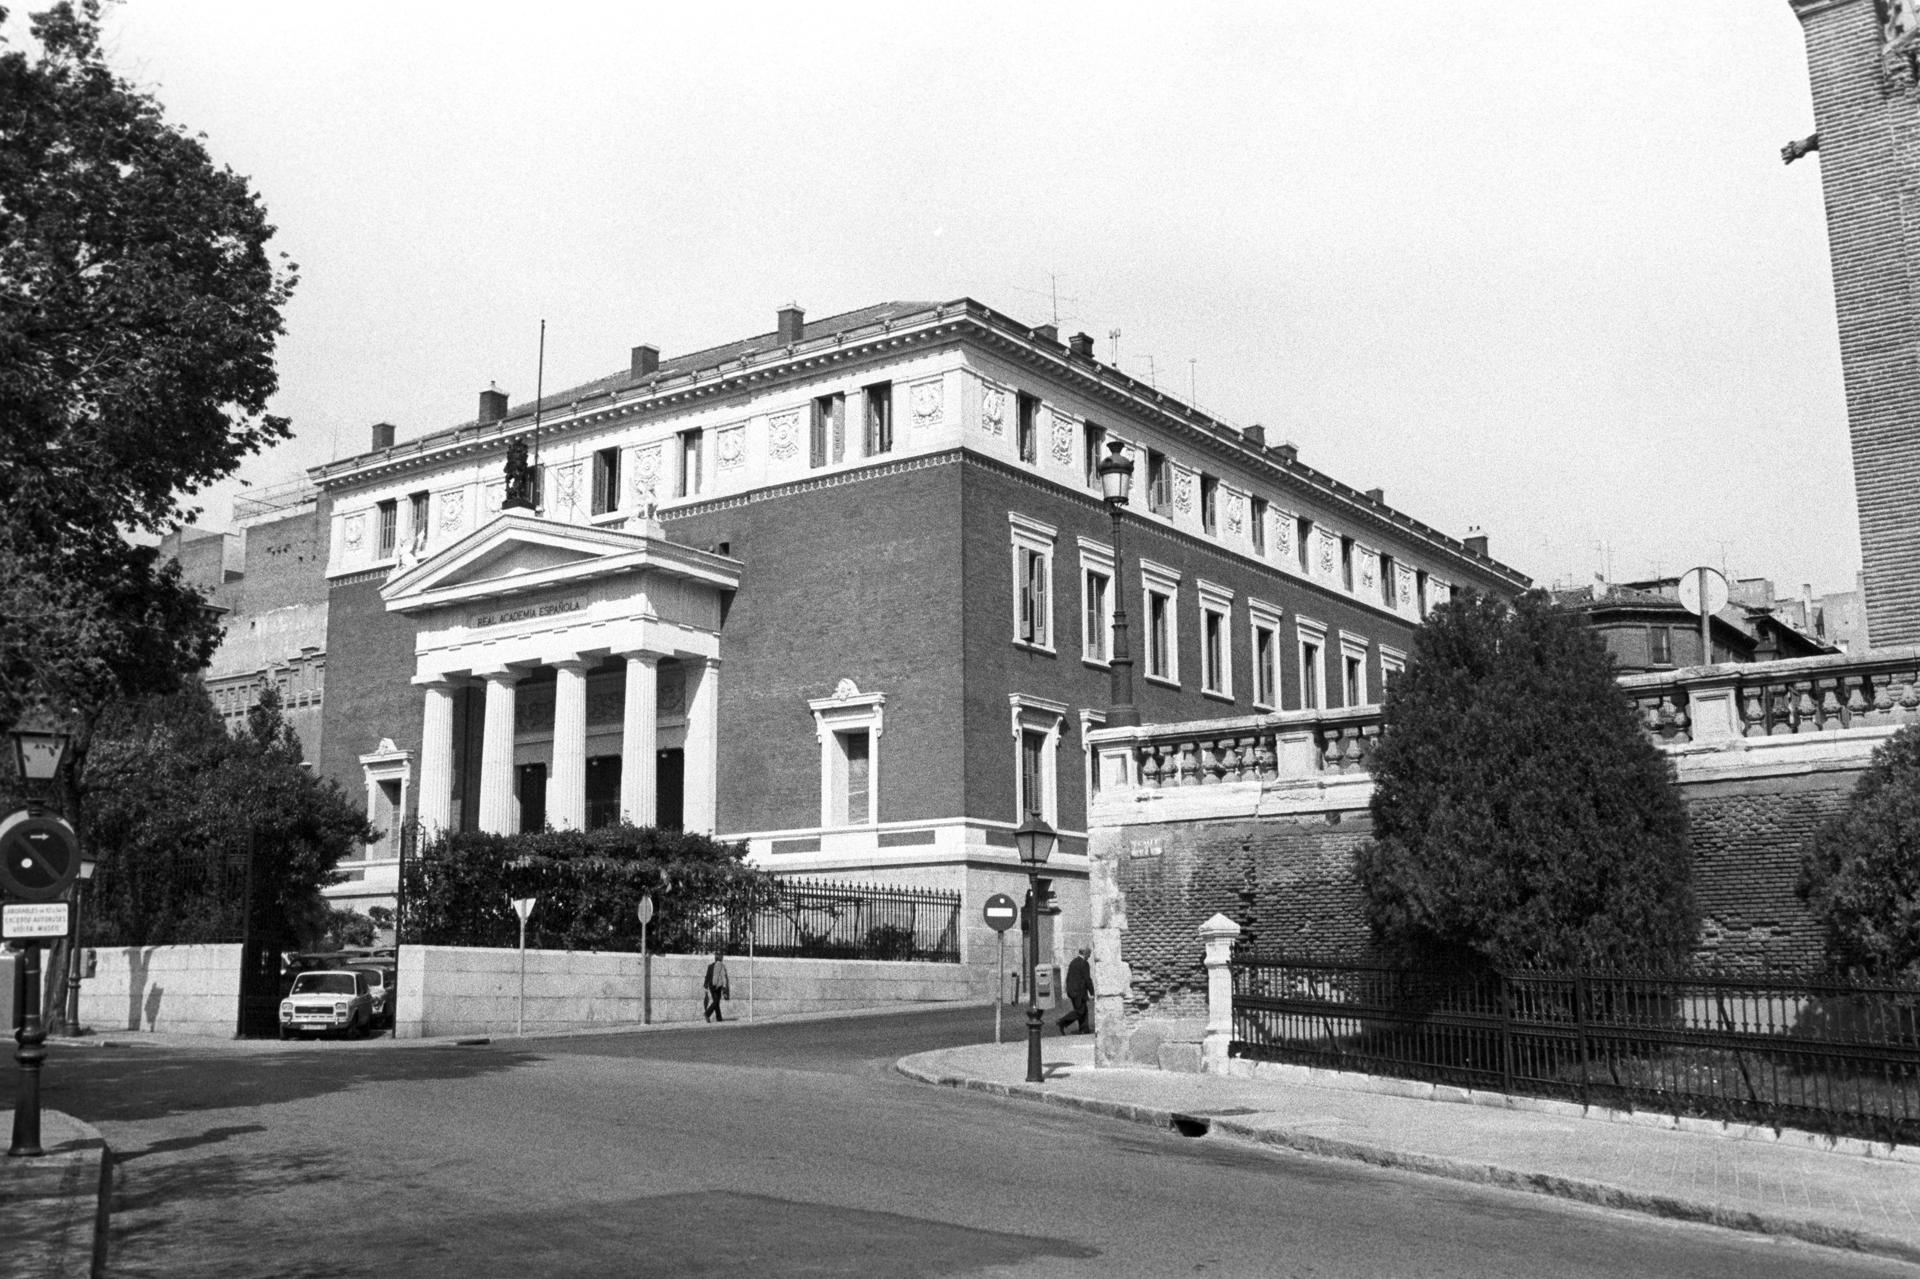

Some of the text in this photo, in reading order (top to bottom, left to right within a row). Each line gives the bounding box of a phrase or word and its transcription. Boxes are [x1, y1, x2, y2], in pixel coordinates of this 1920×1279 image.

[477, 601, 580, 627] REAL ACADEMIA ESPAÑOLA
